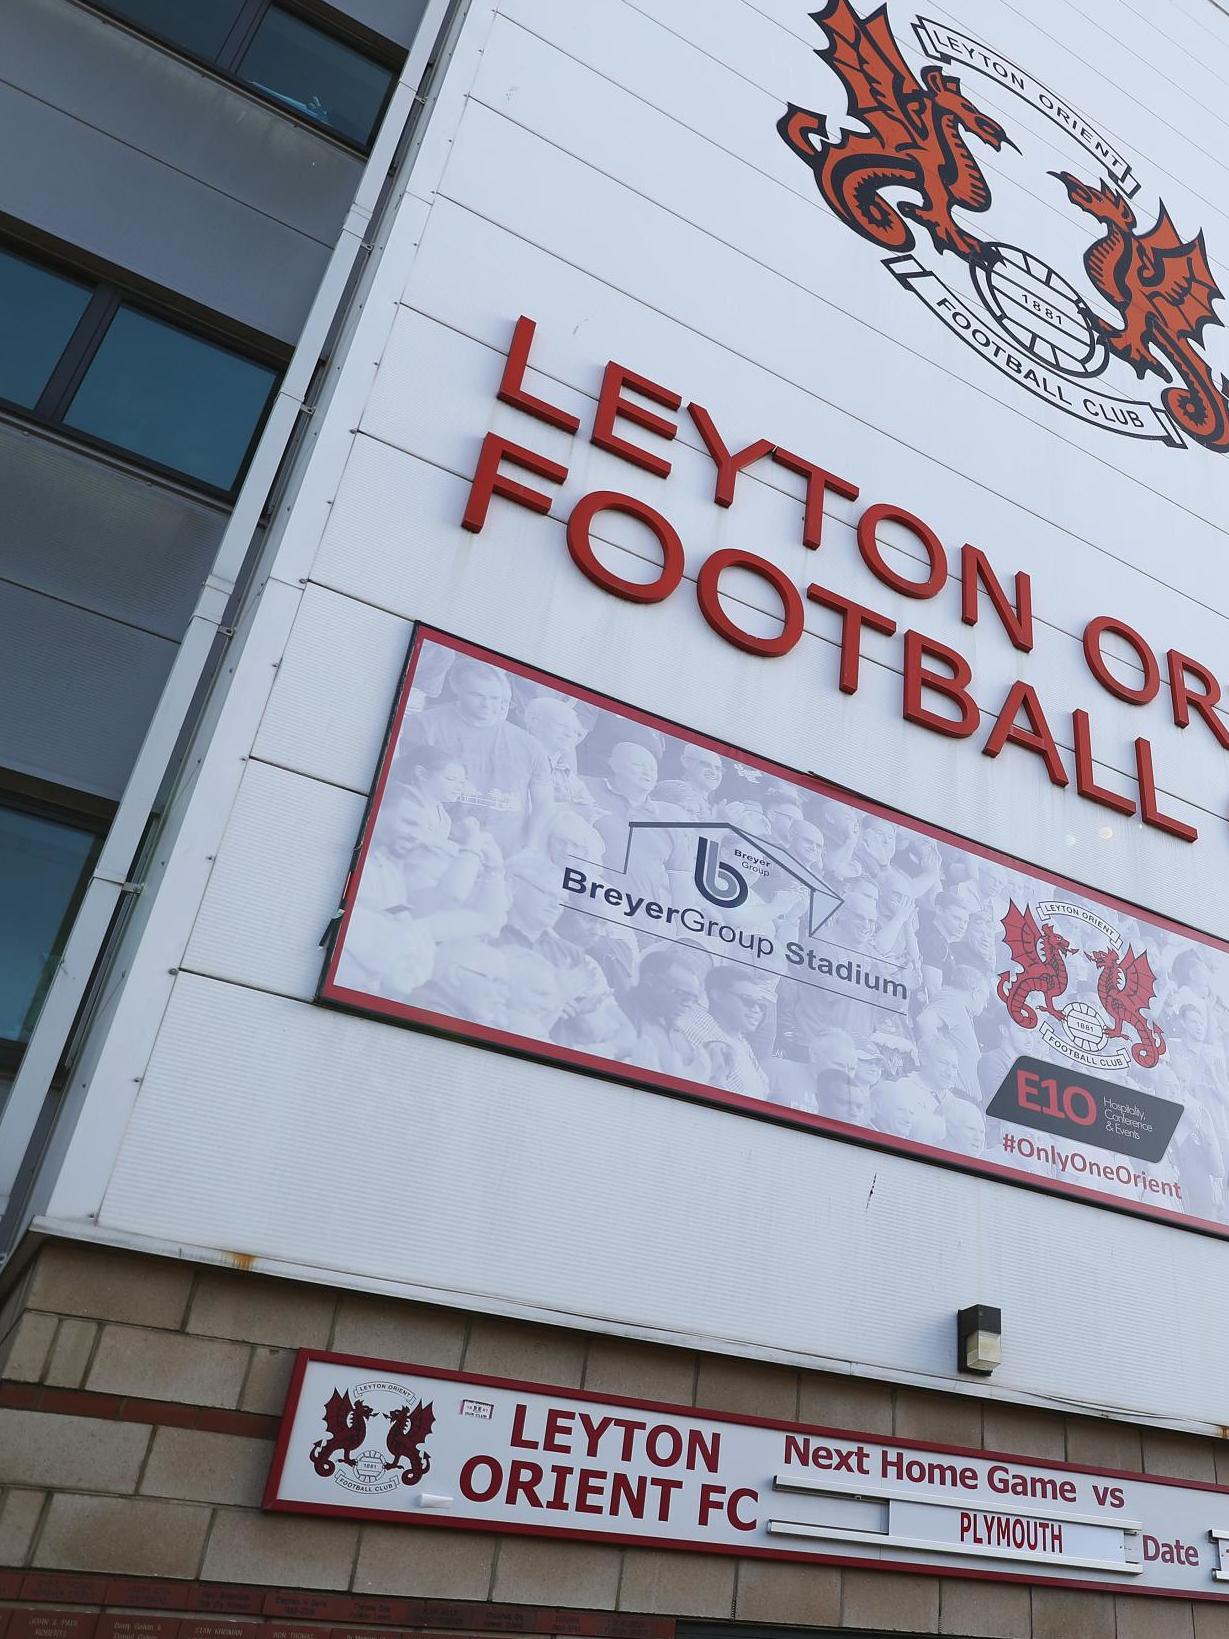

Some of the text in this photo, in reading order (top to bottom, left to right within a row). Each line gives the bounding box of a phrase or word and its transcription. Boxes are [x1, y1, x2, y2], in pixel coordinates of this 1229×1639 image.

[935, 31, 1124, 169] LEYTON ORIENT
[1021, 294, 1063, 325] 1881
[936, 297, 1145, 429] FOOTBALL CLUB
[497, 315, 1033, 652] LEYTON
[461, 431, 1198, 843] FOOTBALL
[734, 849, 771, 867] Breyer
[741, 861, 770, 877] Group
[562, 867, 907, 1000] BreyerGroup Stadium
[1044, 904, 1115, 936] LEYTON ORIENT
[1076, 1021, 1094, 1032] 1881
[1048, 1036, 1123, 1067] FOOTBALL CLUB
[1016, 1068, 1097, 1127] E10
[1105, 1109, 1153, 1132] Conference
[1105, 1120, 1140, 1139] & Events
[1002, 1133, 1183, 1199] #OnlyOneOrient
[388, 1384, 411, 1398] ORIENT
[509, 1403, 721, 1473] LEYTON
[339, 1479, 393, 1492] FOOTBALL CLUB
[783, 1434, 1125, 1508] Next Home Game vs
[459, 1455, 759, 1531] ORIENT FC
[960, 1512, 1063, 1554] PLYMOUTH
[1142, 1535, 1199, 1567] Date
